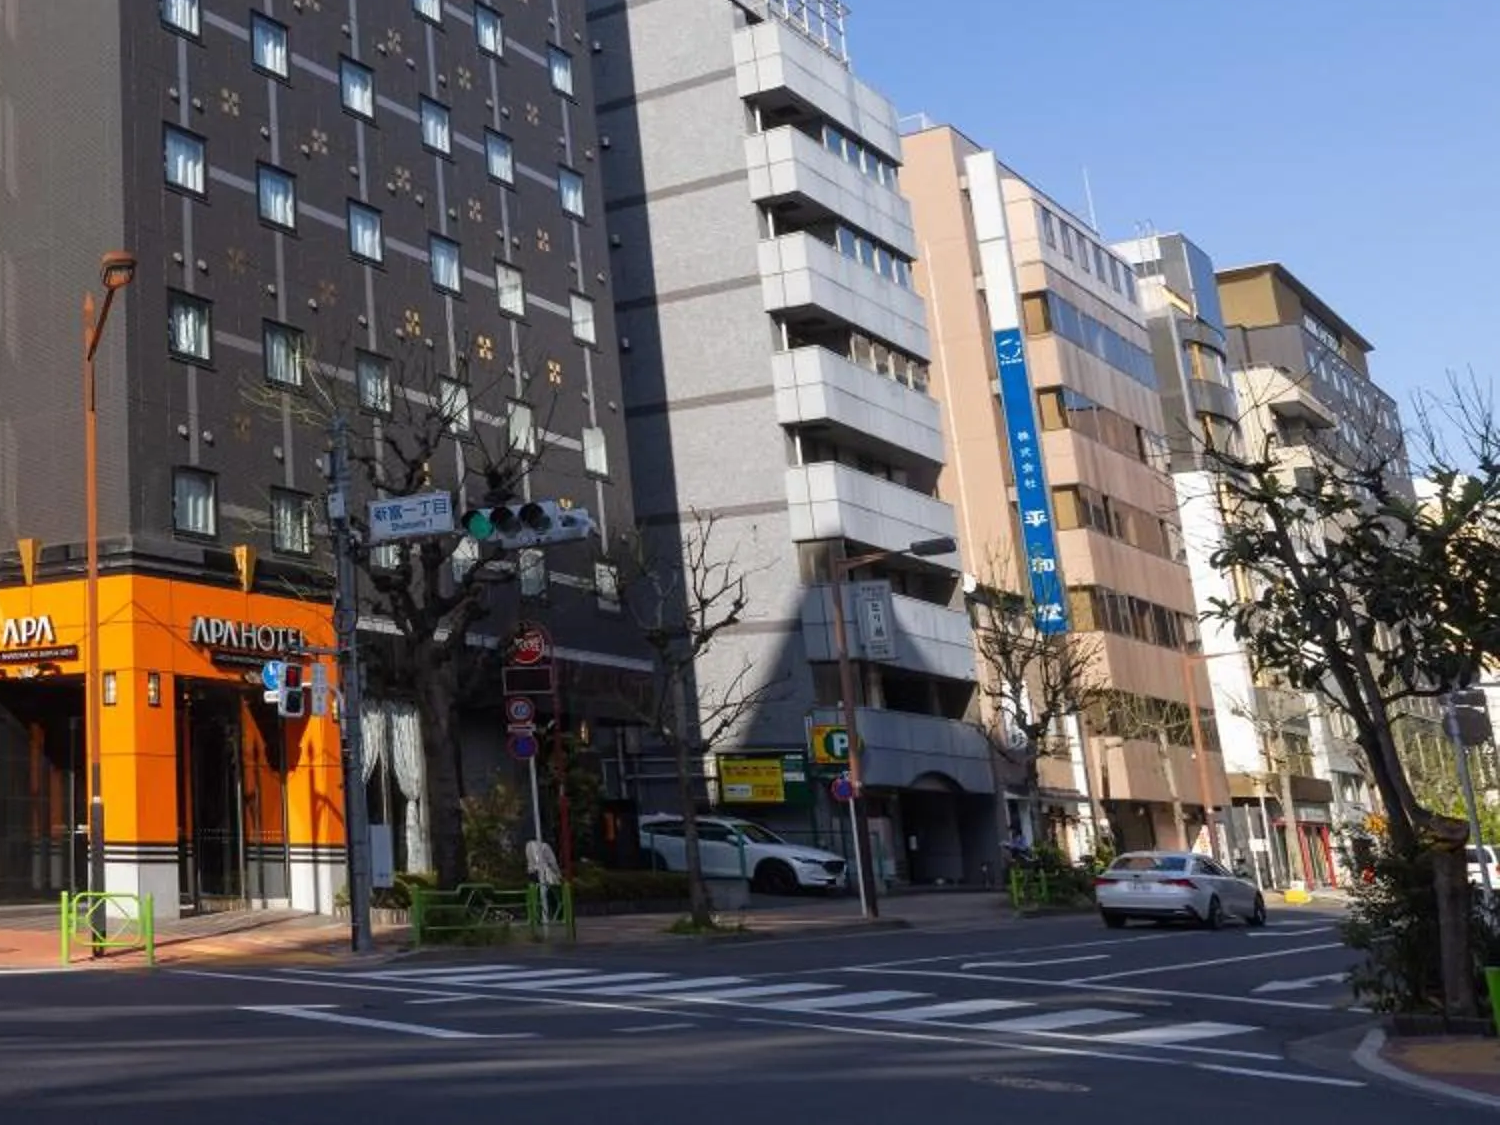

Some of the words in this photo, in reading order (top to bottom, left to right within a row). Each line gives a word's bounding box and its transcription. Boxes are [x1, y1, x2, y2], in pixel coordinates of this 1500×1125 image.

[3, 615, 55, 646] APA
[192, 616, 239, 648] APA
[240, 623, 307, 651] HOTEL
[832, 733, 849, 759] P
